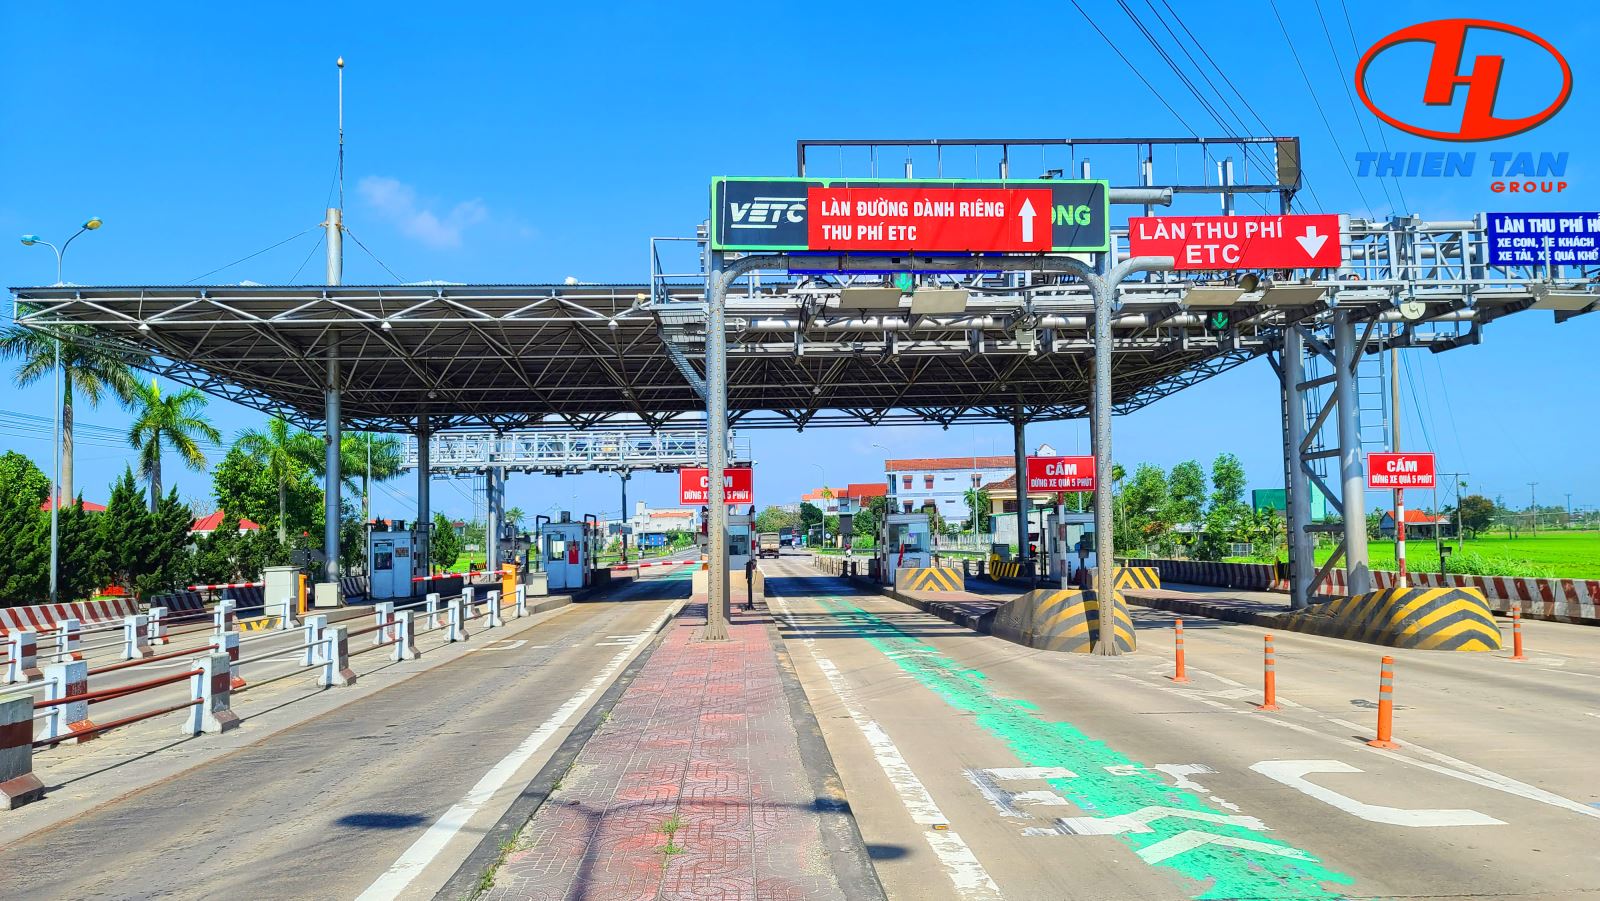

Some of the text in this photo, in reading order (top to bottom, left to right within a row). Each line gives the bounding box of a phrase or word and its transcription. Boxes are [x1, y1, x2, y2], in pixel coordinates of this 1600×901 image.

[729, 202, 807, 223] VETC
[821, 197, 1005, 217] LÀN ĐƯỜNG DÀNH RIÊNG
[1051, 204, 1091, 226] NG
[821, 222, 917, 241] THU PHÍ ETC
[1139, 217, 1283, 240] LÀN THU PHÍ
[1495, 216, 1525, 233] LÀN
[1528, 218, 1556, 233] THU
[1559, 215, 1584, 233] PHÍ
[1497, 237, 1512, 248] XE
[1558, 235, 1595, 247] KHÁCH
[1186, 244, 1241, 264] ETC
[1498, 251, 1513, 261] XE
[1554, 249, 1576, 262] QUÁ
[1045, 460, 1078, 476] CẤM
[1386, 457, 1418, 472] CẤM
[700, 476, 733, 488] CM
[1049, 478, 1057, 487] XE
[1390, 474, 1398, 484] XE
